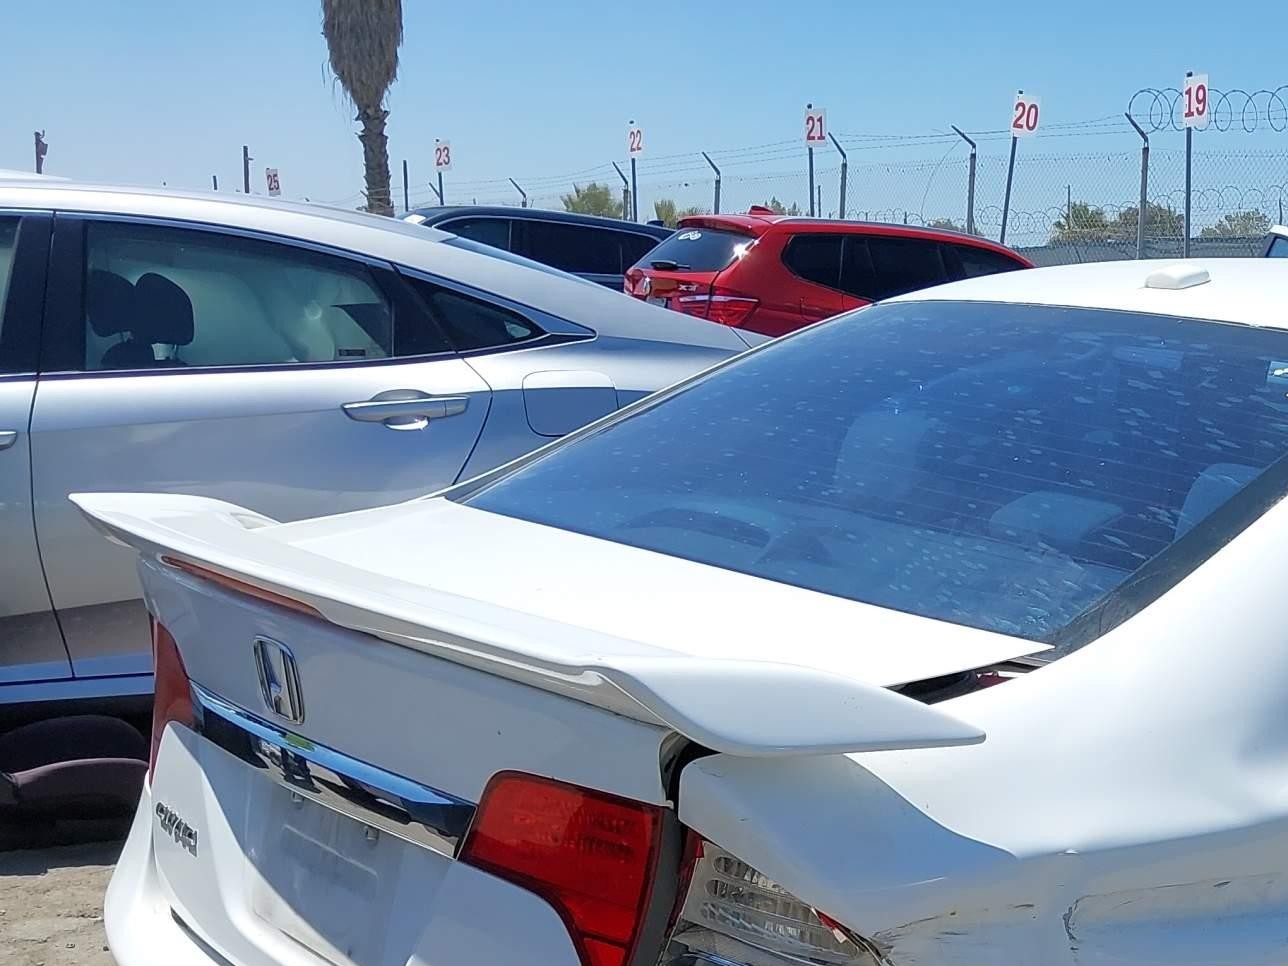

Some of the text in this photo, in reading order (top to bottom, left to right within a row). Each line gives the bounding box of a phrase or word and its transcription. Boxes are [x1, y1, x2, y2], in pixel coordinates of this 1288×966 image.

[1184, 84, 1207, 118] 19
[806, 115, 826, 141] 21
[1012, 102, 1039, 131] 20
[629, 129, 643, 153] 22
[435, 146, 451, 166] 23
[266, 173, 280, 191] 25
